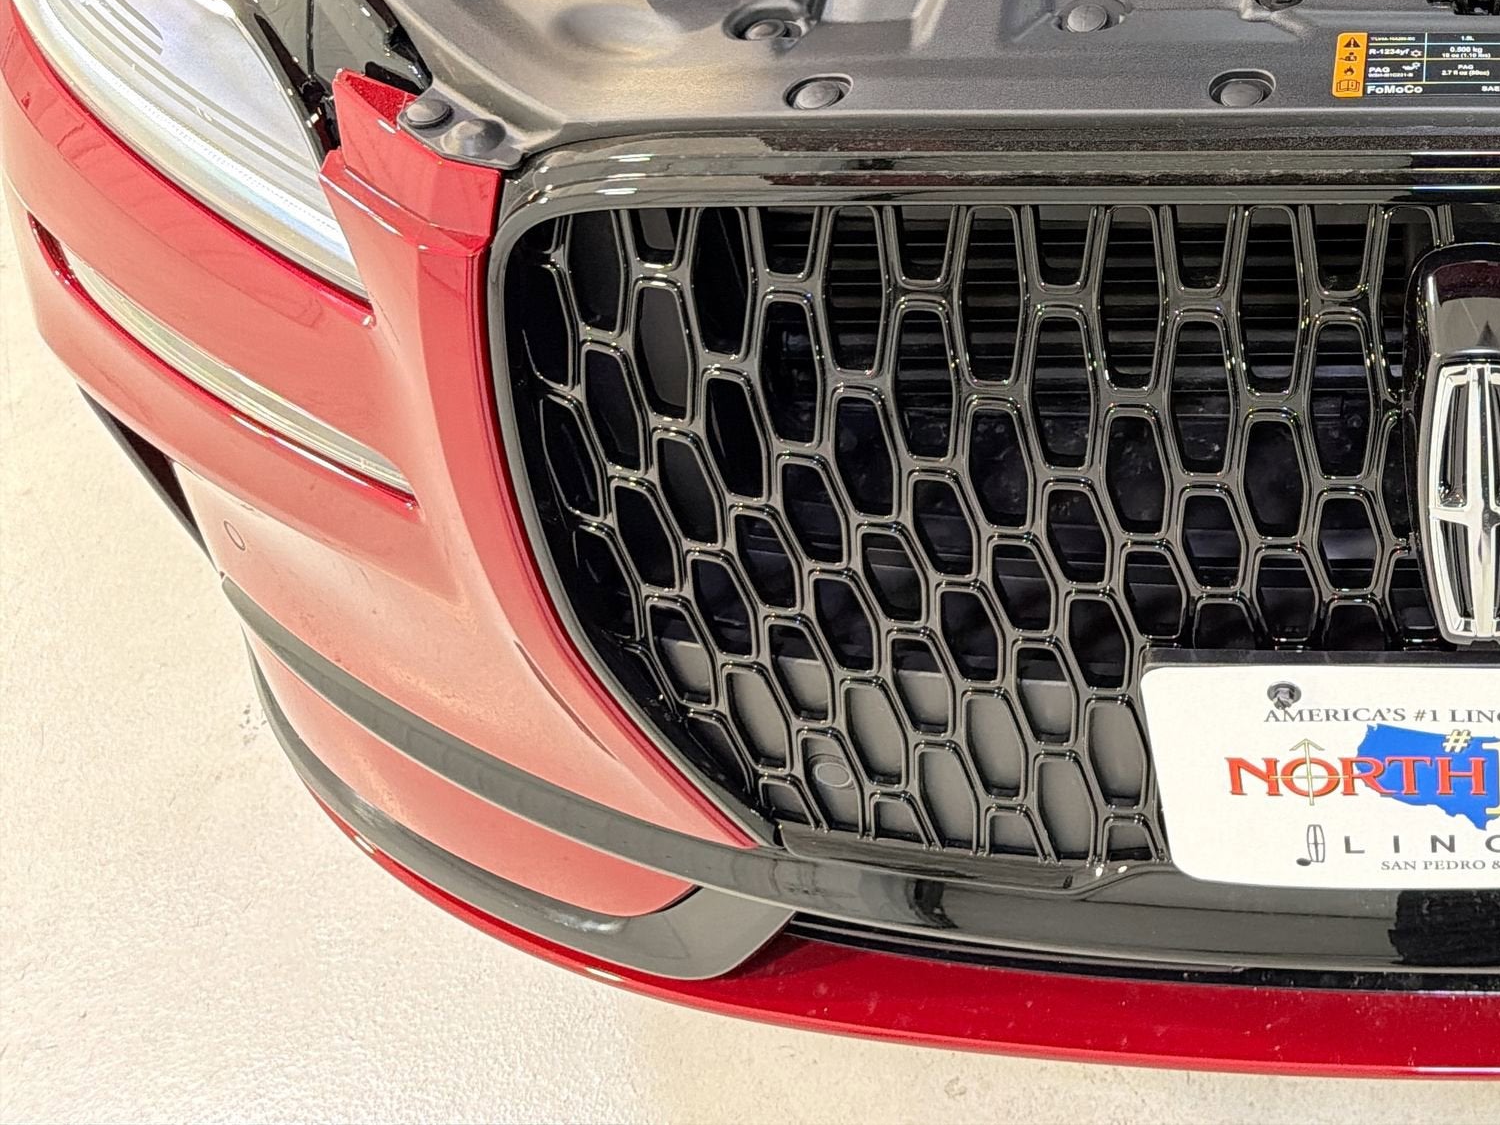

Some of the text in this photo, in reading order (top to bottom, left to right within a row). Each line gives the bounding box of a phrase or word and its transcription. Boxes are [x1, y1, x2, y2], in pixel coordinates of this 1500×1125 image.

[1369, 48, 1410, 58] R-1234yf
[1472, 46, 1484, 54] kg
[1367, 84, 1423, 95] FoMoCo
[1264, 708, 1407, 723] AMERICA'S
[1415, 710, 1440, 722] #1
[1224, 756, 1490, 798] NORTH
[1380, 860, 1417, 871] SAN
[1423, 860, 1486, 871] PEDRO
